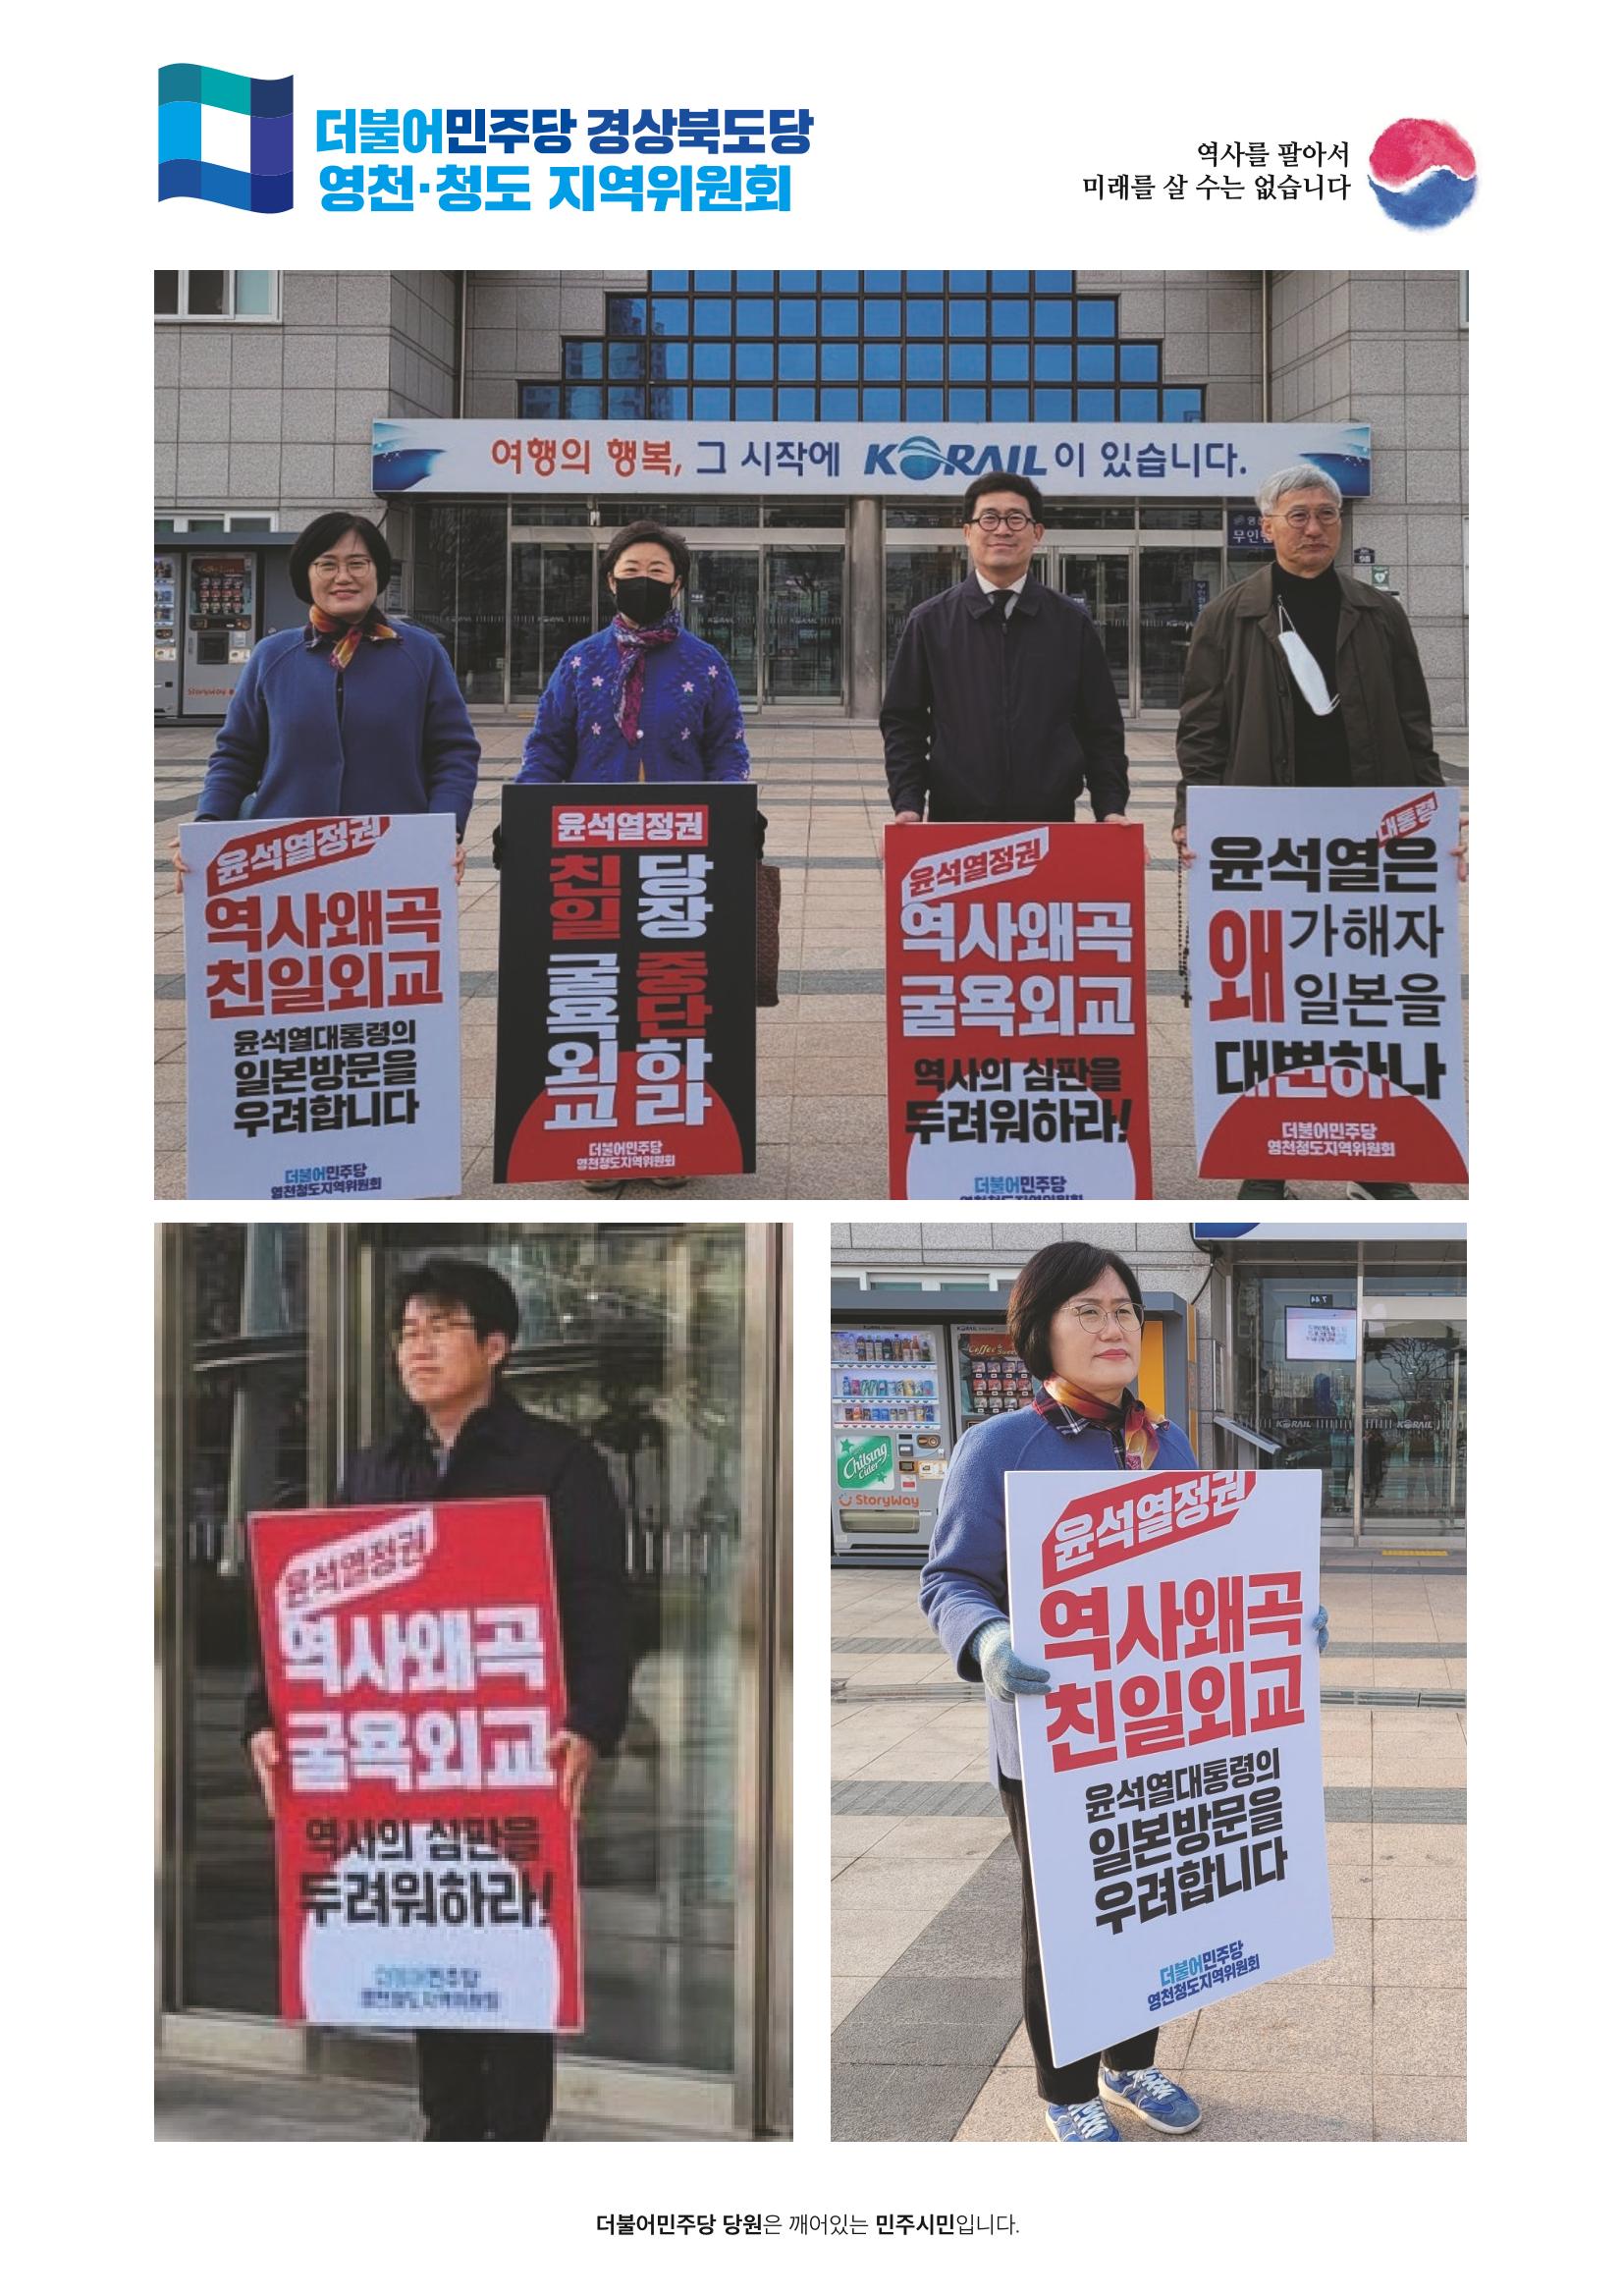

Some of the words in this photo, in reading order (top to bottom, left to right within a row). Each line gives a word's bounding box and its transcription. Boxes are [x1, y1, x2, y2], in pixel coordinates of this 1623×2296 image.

[492, 437, 590, 476] 여행의
[607, 437, 682, 477] 행복,
[696, 441, 727, 474] 그
[741, 440, 840, 477] 시작에
[1101, 441, 1246, 478] 있습니다.
[558, 812, 703, 842] 윤석열정권
[1379, 798, 1435, 842] 대통령
[217, 817, 381, 886] 윤석열정권
[909, 837, 1042, 897] 윤석열정권
[1209, 836, 1438, 893] 윤석열은
[205, 888, 442, 953] 역사왜곡
[549, 854, 621, 941] 친일
[638, 854, 714, 939] 당장
[900, 902, 1133, 962] 역사왜곡
[206, 951, 443, 1019] 친일외교
[1209, 909, 1284, 1023] 왜
[1288, 904, 1444, 958] 가해자
[900, 975, 1135, 1037] 굴욕외교
[1294, 972, 1446, 1027] 일본을
[234, 1020, 416, 1057] 윤석열대통령의
[544, 953, 621, 1130] 굴욕외교
[635, 952, 713, 1126] 중단하라
[234, 1049, 417, 1097] 일본방문을
[914, 1058, 1011, 1093] 역사의
[1023, 1058, 1122, 1093] 심판을
[1215, 1040, 1447, 1100] 대변하나
[234, 1090, 419, 1138] 우려합니다
[905, 1099, 1132, 1144] 두려워하라!
[1281, 1121, 1378, 1139] 더불어민주당
[285, 1163, 367, 1184] 더불어민주당
[589, 1140, 663, 1157] 더불어민주당
[974, 1175, 1067, 1194] 더불어민주당
[1054, 1472, 1246, 1567] 윤석열정권
[281, 1605, 545, 1694] 역사왜곡
[1039, 1571, 1303, 1671] 역사왜곡
[1047, 1655, 1305, 1773] 친일외교
[288, 1707, 556, 1791] 굴욕외교
[1085, 1748, 1280, 1824] 윤석열대통령의
[305, 1818, 411, 1861] 역사의
[425, 1816, 539, 1861] 심판을
[1089, 1786, 1282, 1881] 일본방문을
[300, 1871, 554, 1927] 두려워하라!
[1095, 1836, 1287, 1935] 우려합니다
[1160, 1940, 1244, 1987] 더불어민주당
